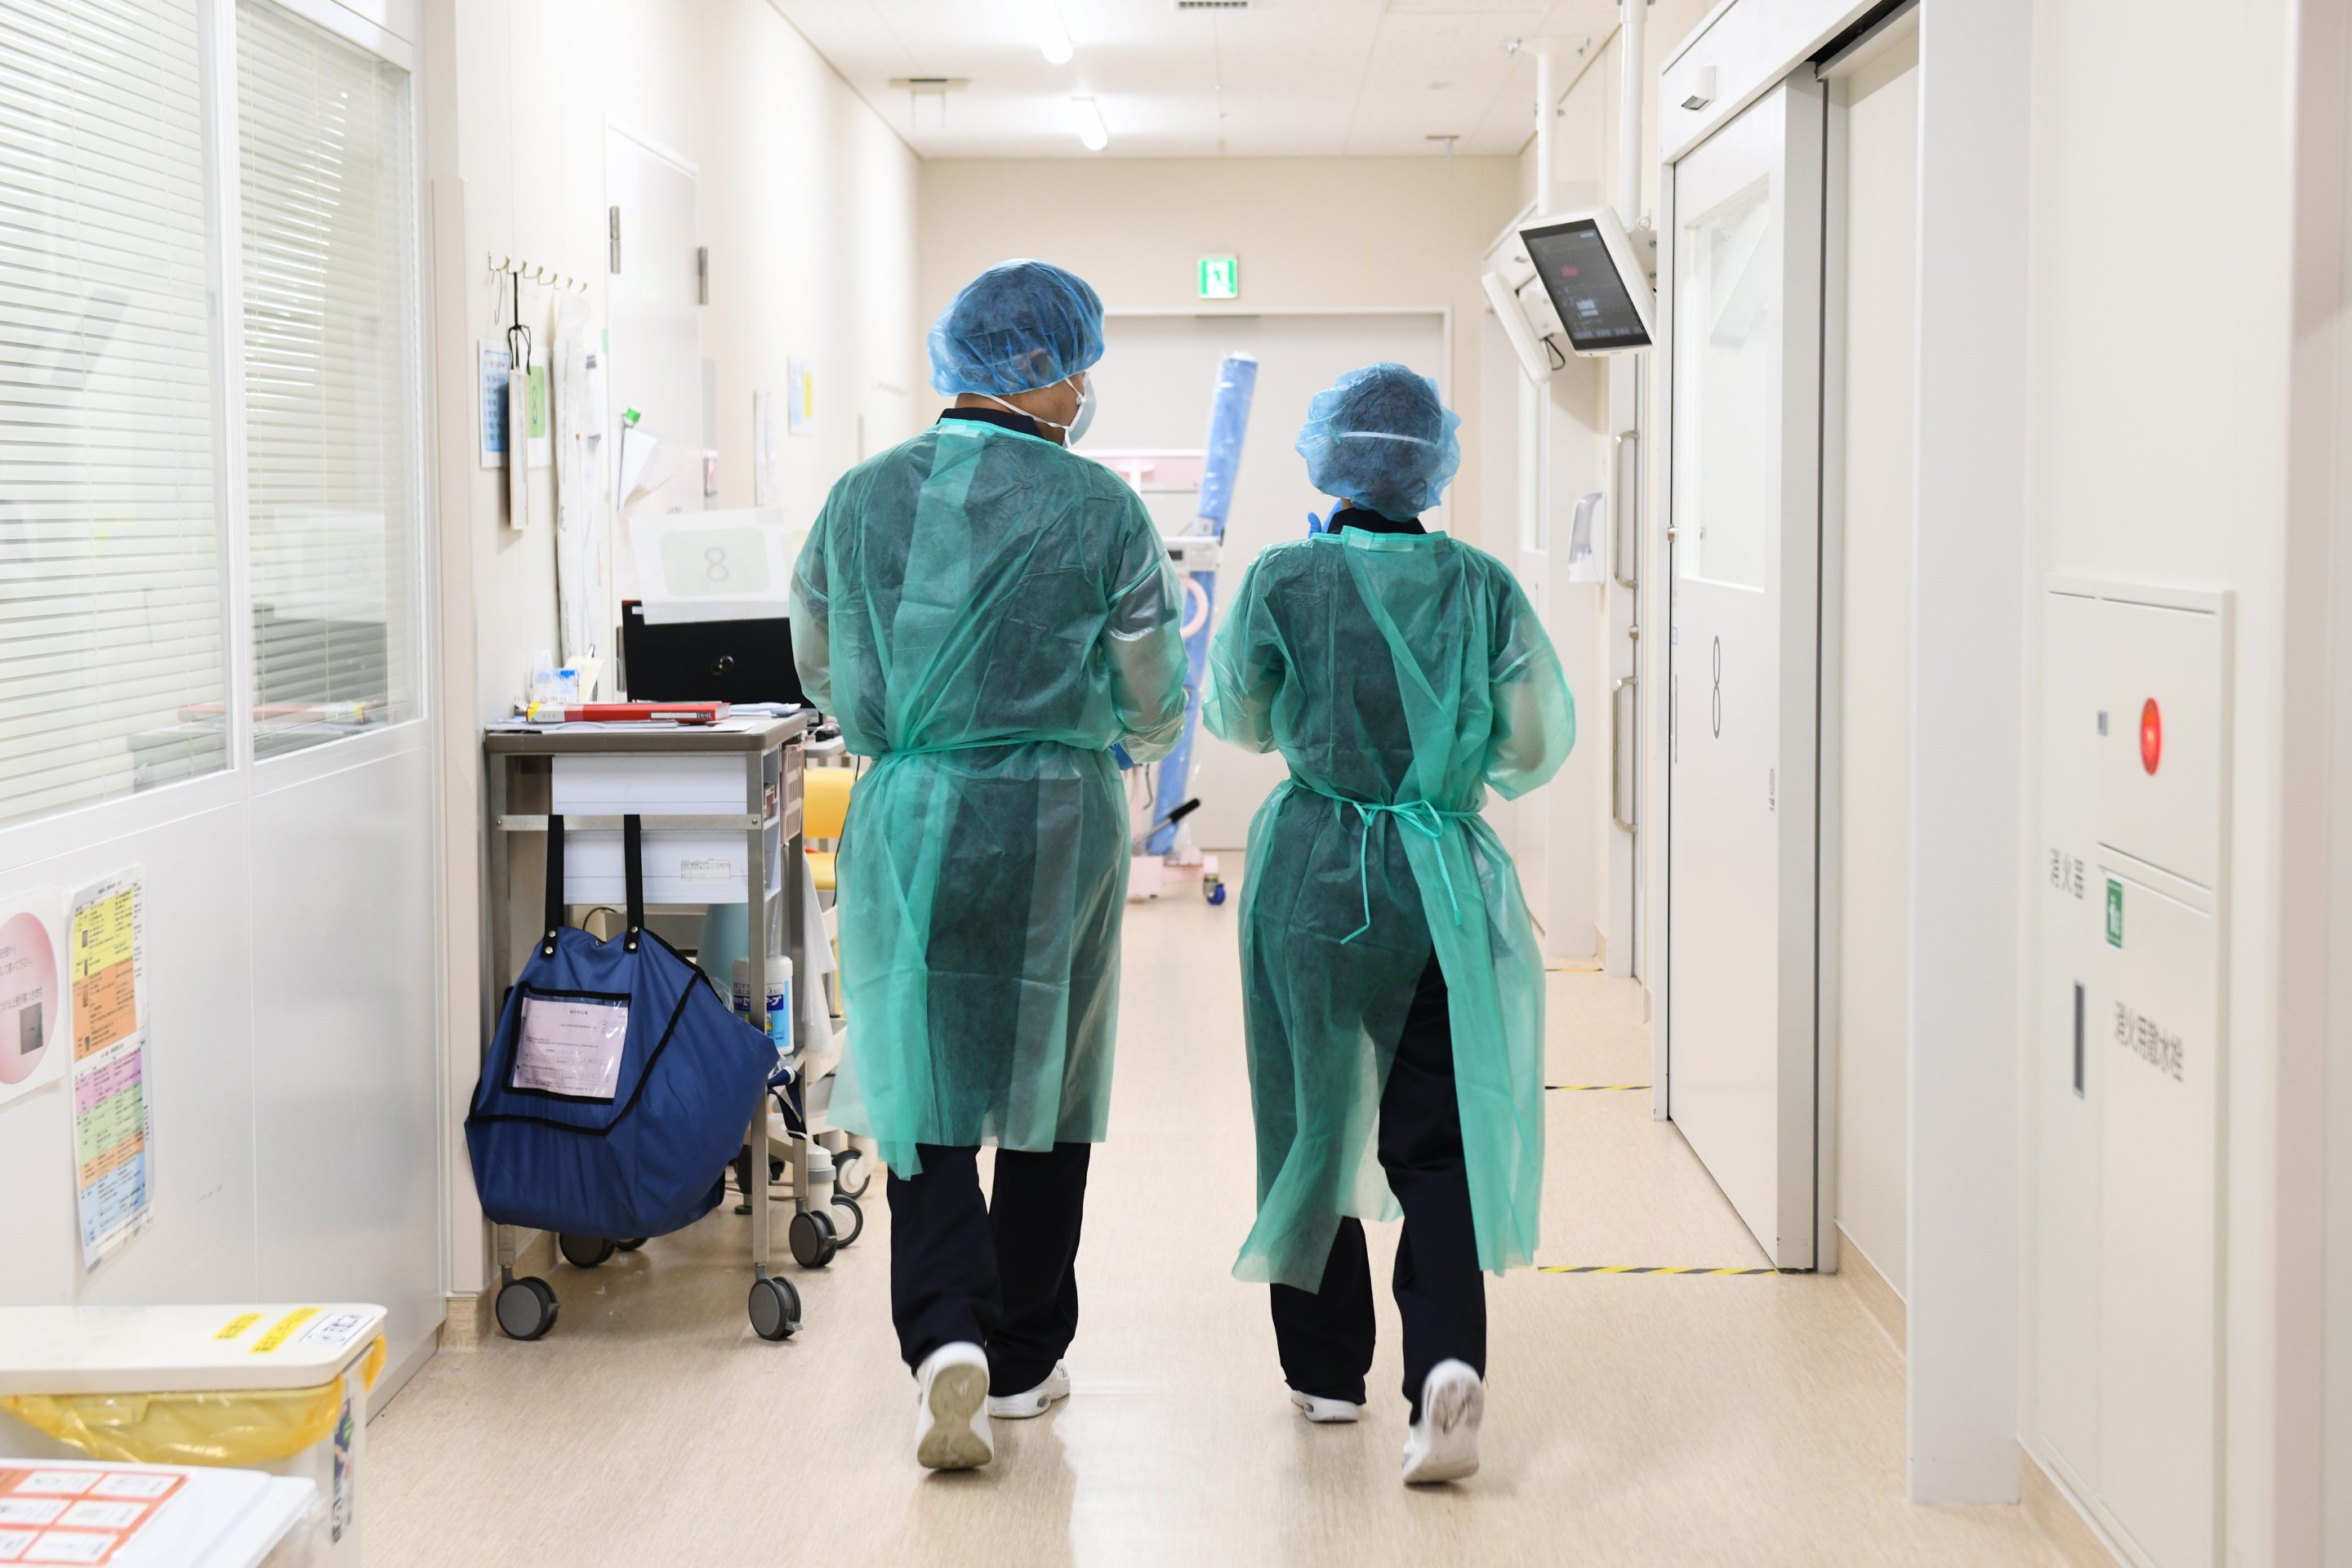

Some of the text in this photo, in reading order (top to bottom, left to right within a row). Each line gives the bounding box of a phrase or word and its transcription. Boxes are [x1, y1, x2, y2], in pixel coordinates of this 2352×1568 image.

[703, 546, 730, 582] 8
[1713, 635, 1721, 739] 8
[2050, 847, 2084, 900] 消火器
